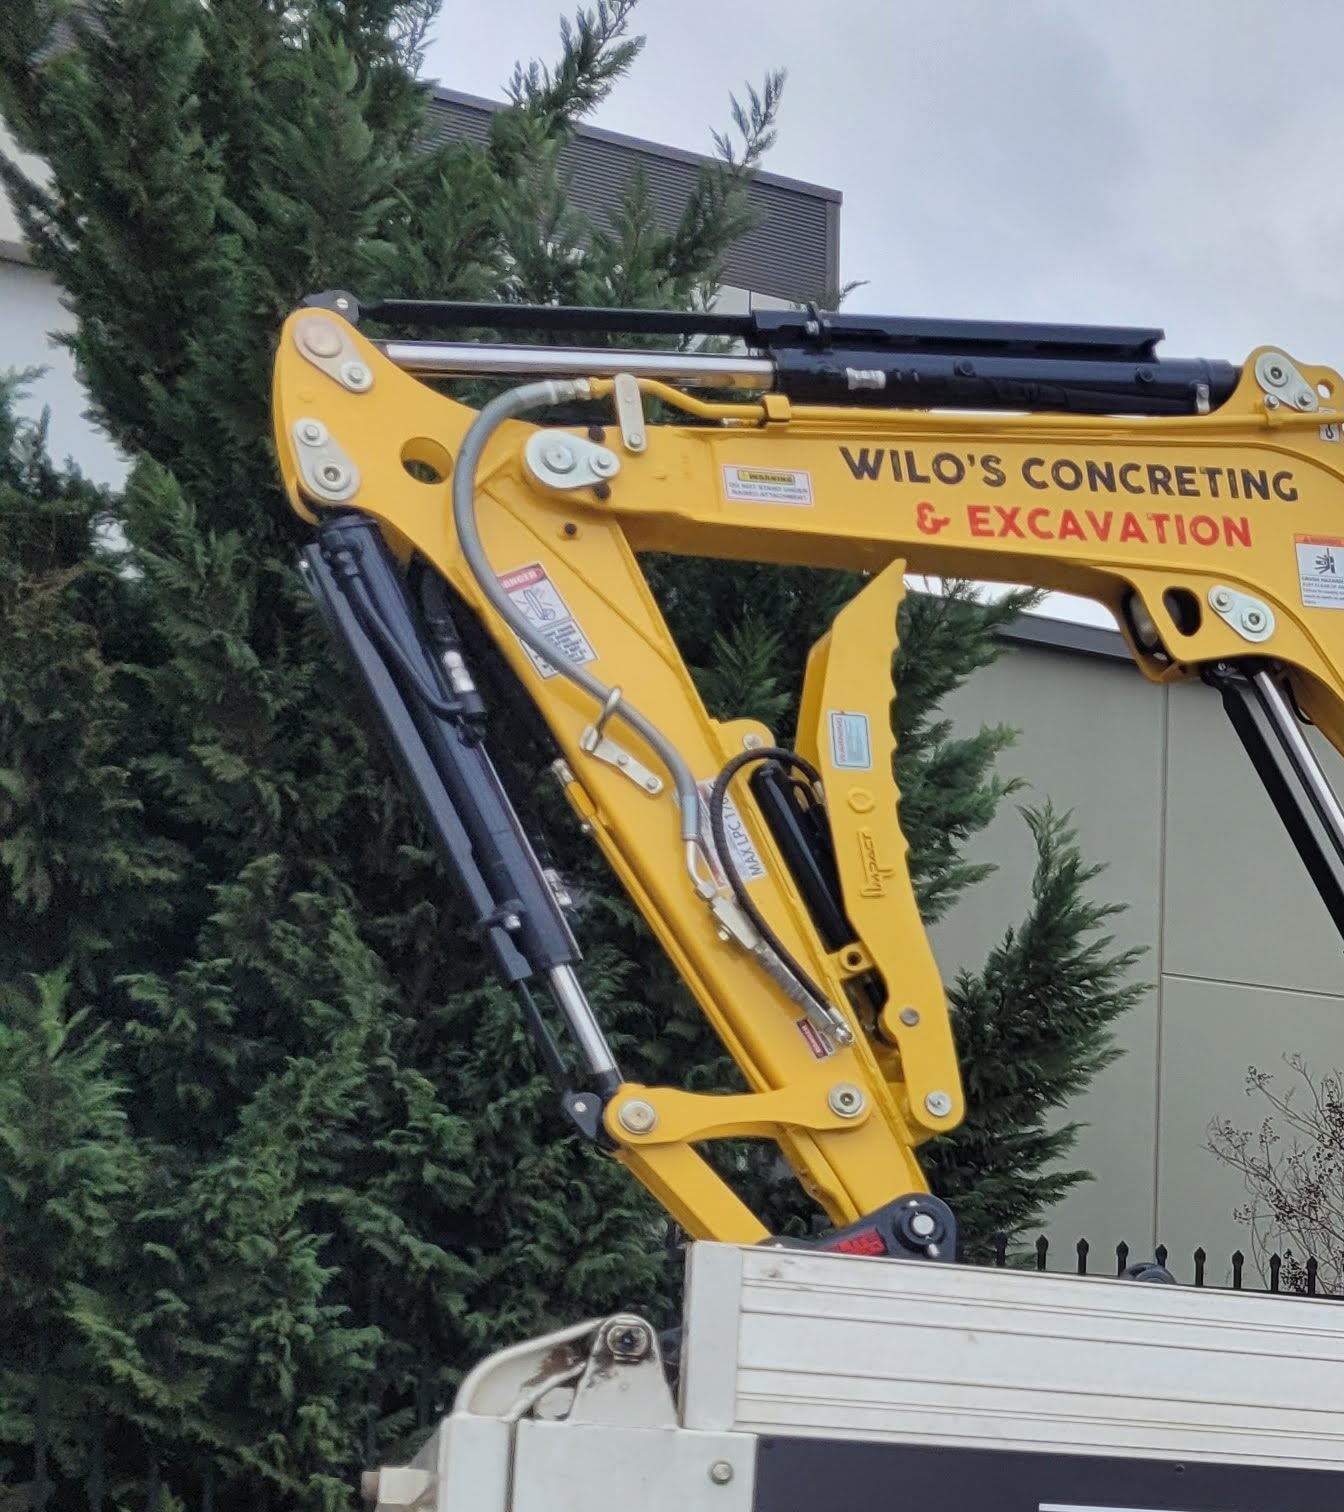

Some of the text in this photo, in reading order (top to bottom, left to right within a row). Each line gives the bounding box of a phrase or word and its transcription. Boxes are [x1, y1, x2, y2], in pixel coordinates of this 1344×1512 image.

[839, 446, 1299, 502] WILO'S CONCRETING
[916, 502, 1252, 548] & EXCAVATION
[726, 818, 748, 849] LPC
[739, 848, 764, 877] MAX
